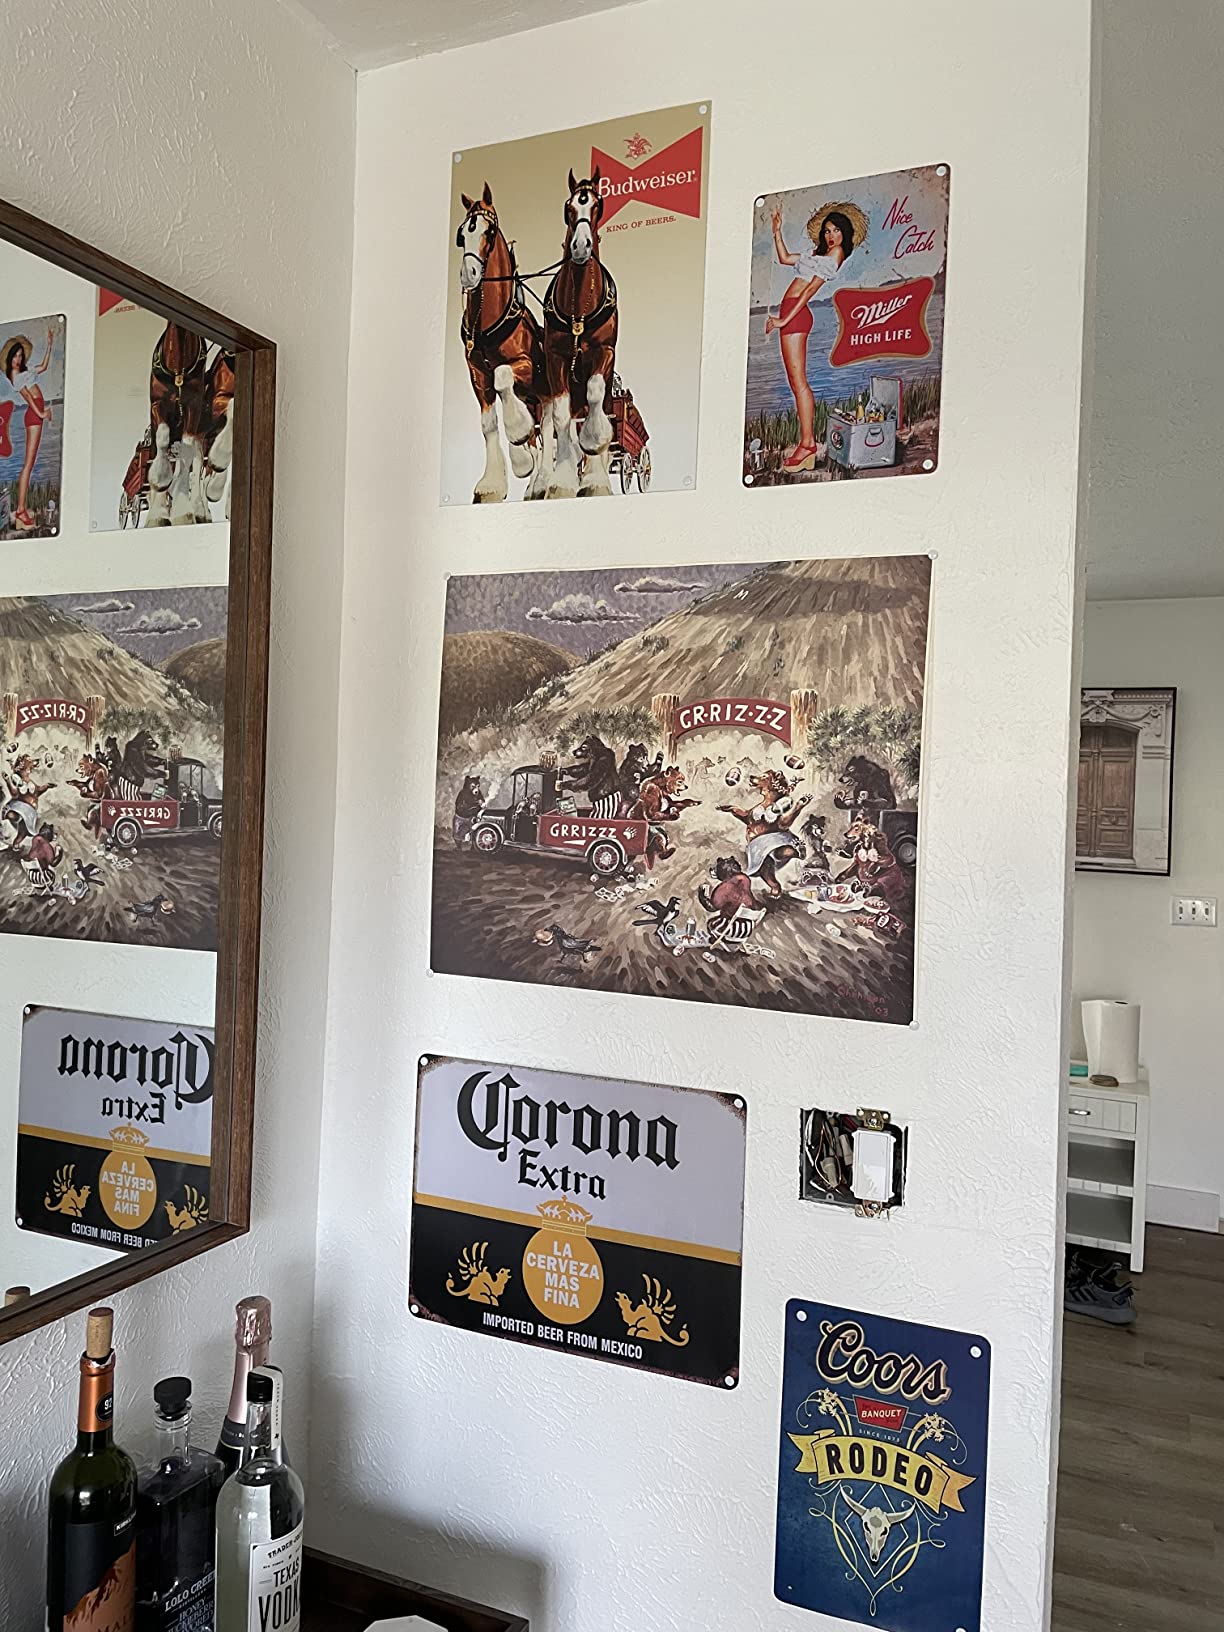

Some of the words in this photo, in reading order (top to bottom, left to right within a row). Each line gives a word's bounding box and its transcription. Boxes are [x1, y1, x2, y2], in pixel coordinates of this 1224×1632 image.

[598, 169, 696, 198] Budweiser
[606, 223, 629, 233] KING
[630, 220, 644, 229] OF
[881, 195, 913, 231] Nice
[894, 225, 937, 260] Catch
[850, 294, 913, 329] Miller
[850, 332, 882, 346] HIGH
[885, 328, 912, 343] LIFE
[549, 822, 617, 839] GRRIZZZ
[456, 1070, 681, 1171] Corona
[517, 1147, 607, 1201] Extra
[552, 1240, 573, 1258] LA
[526, 1251, 600, 1281] CERVEZA
[545, 1271, 580, 1292] MAS
[543, 1287, 580, 1309] FINA
[482, 1311, 535, 1336] IMPORTED
[537, 1324, 564, 1343] BEER
[567, 1331, 598, 1350] FROM
[601, 1338, 643, 1360] MEXICO
[815, 1319, 952, 1406] Coors
[861, 1409, 902, 1418] BANQUET
[825, 1442, 934, 1497] RODEO
[267, 1540, 293, 1559] TRADER
[272, 1556, 300, 1588] TEXAS
[164, 1589, 189, 1613] LOLO
[190, 1569, 215, 1595] CREE
[258, 1576, 300, 1632] VODK
